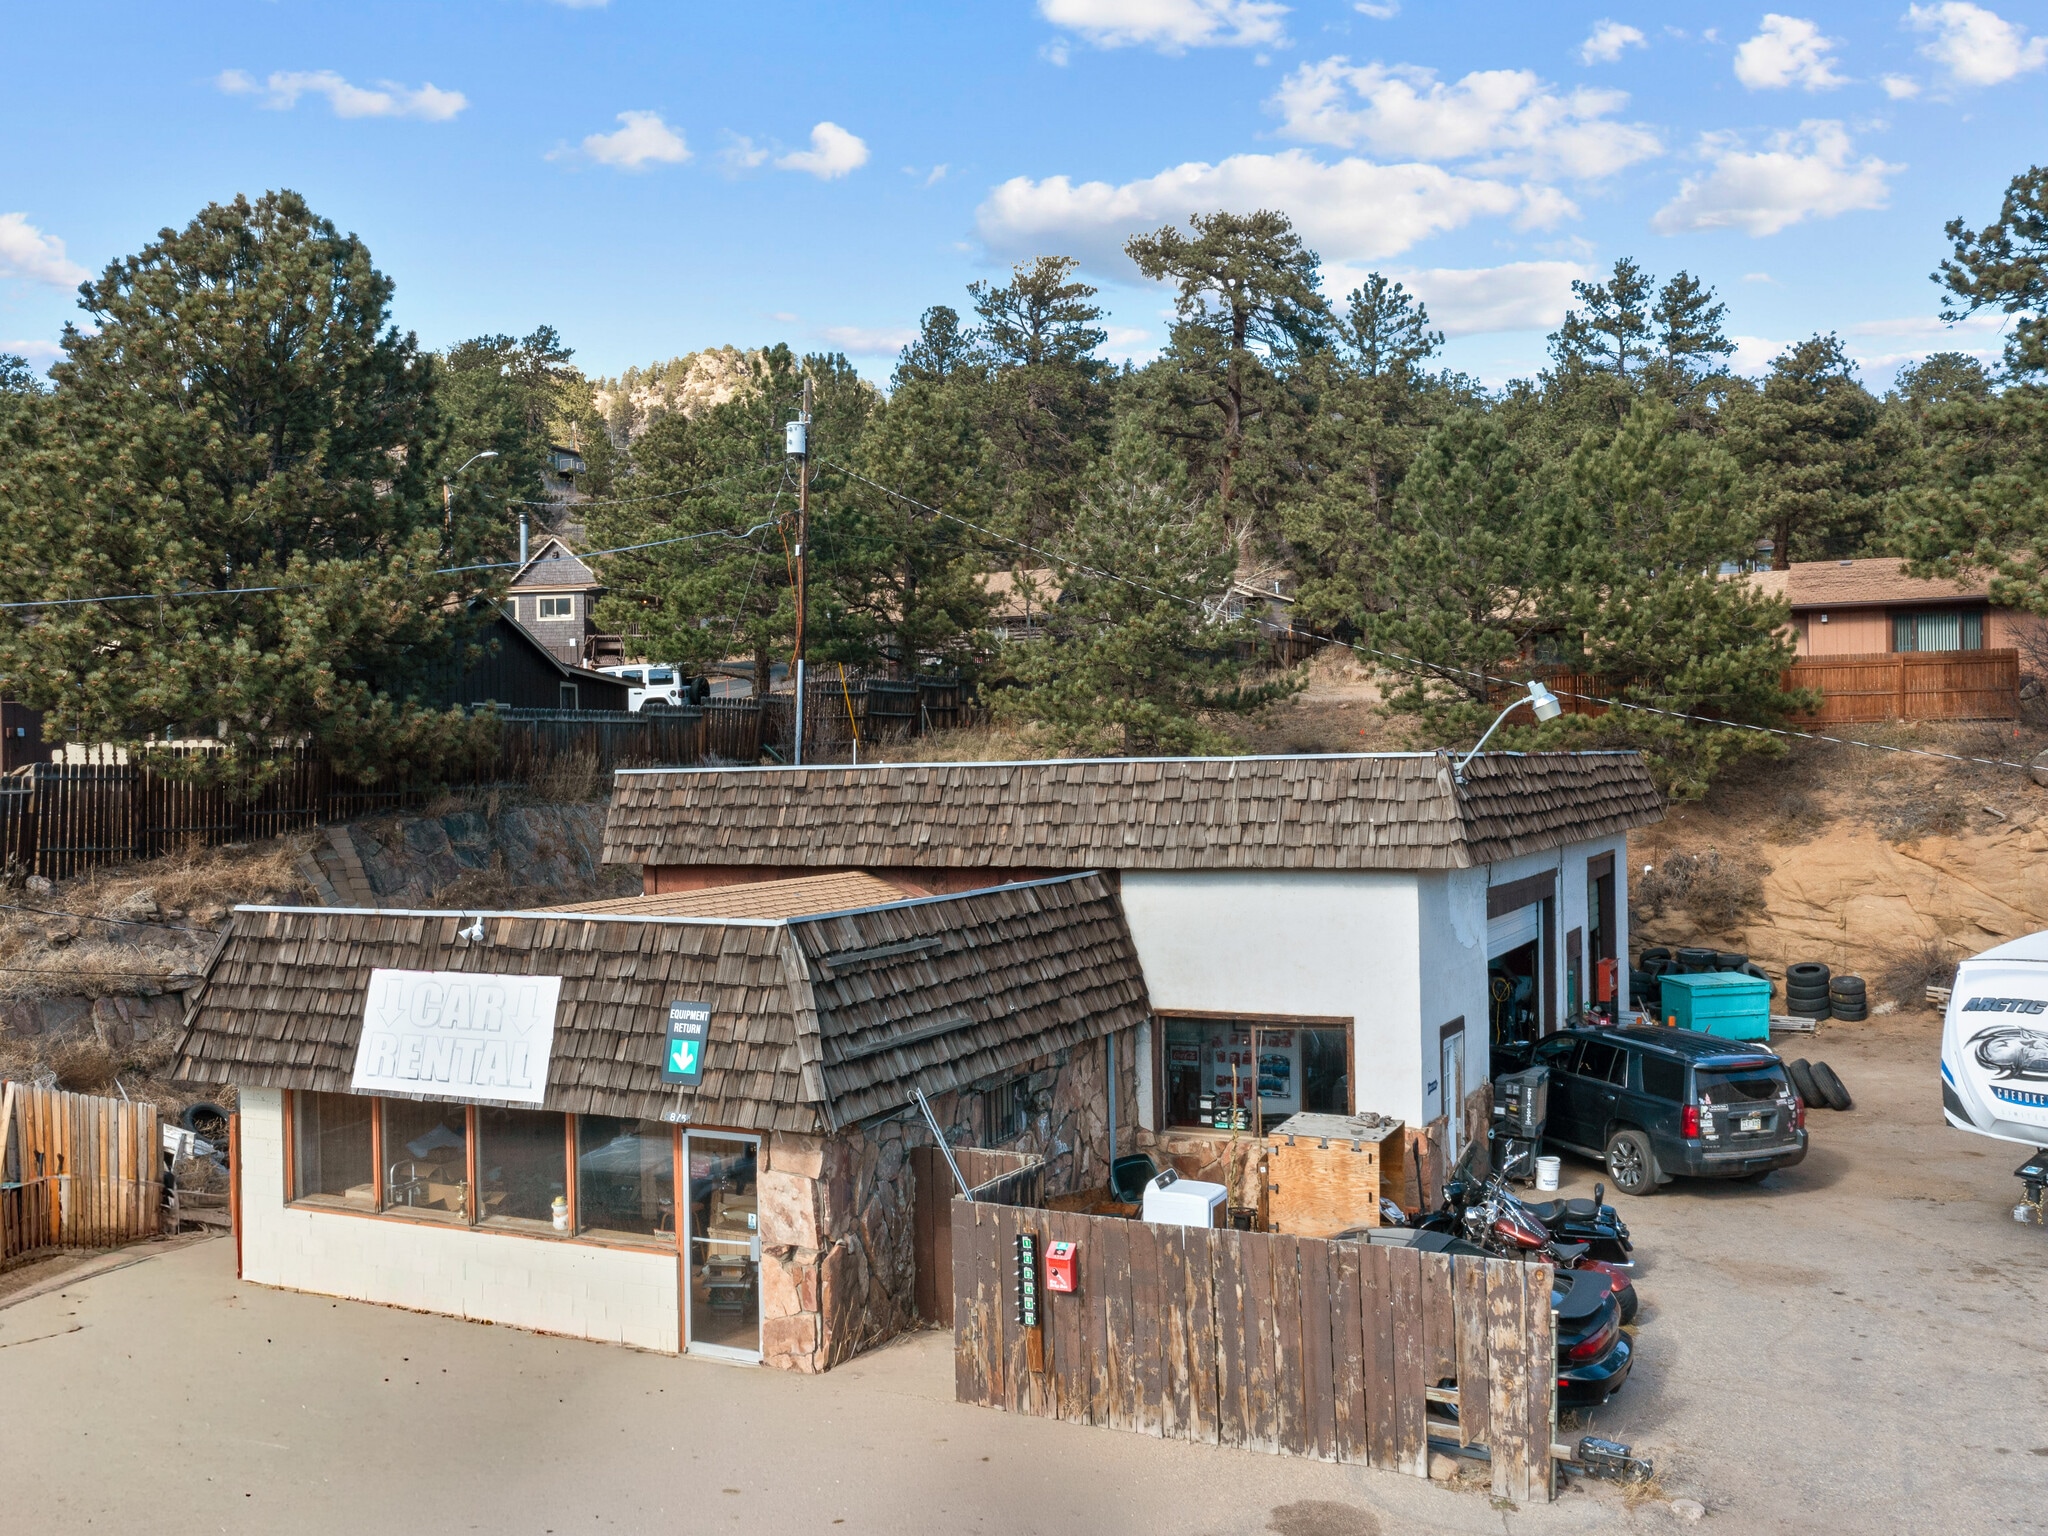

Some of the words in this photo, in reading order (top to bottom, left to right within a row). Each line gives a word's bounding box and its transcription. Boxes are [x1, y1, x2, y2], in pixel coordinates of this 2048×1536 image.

[410, 981, 506, 1032] CAR
[670, 1008, 710, 1021] EQUIPMENT
[1962, 997, 2048, 1015] ARCTIC
[673, 1023, 702, 1034] RETURN
[366, 1032, 532, 1089] RENTAL
